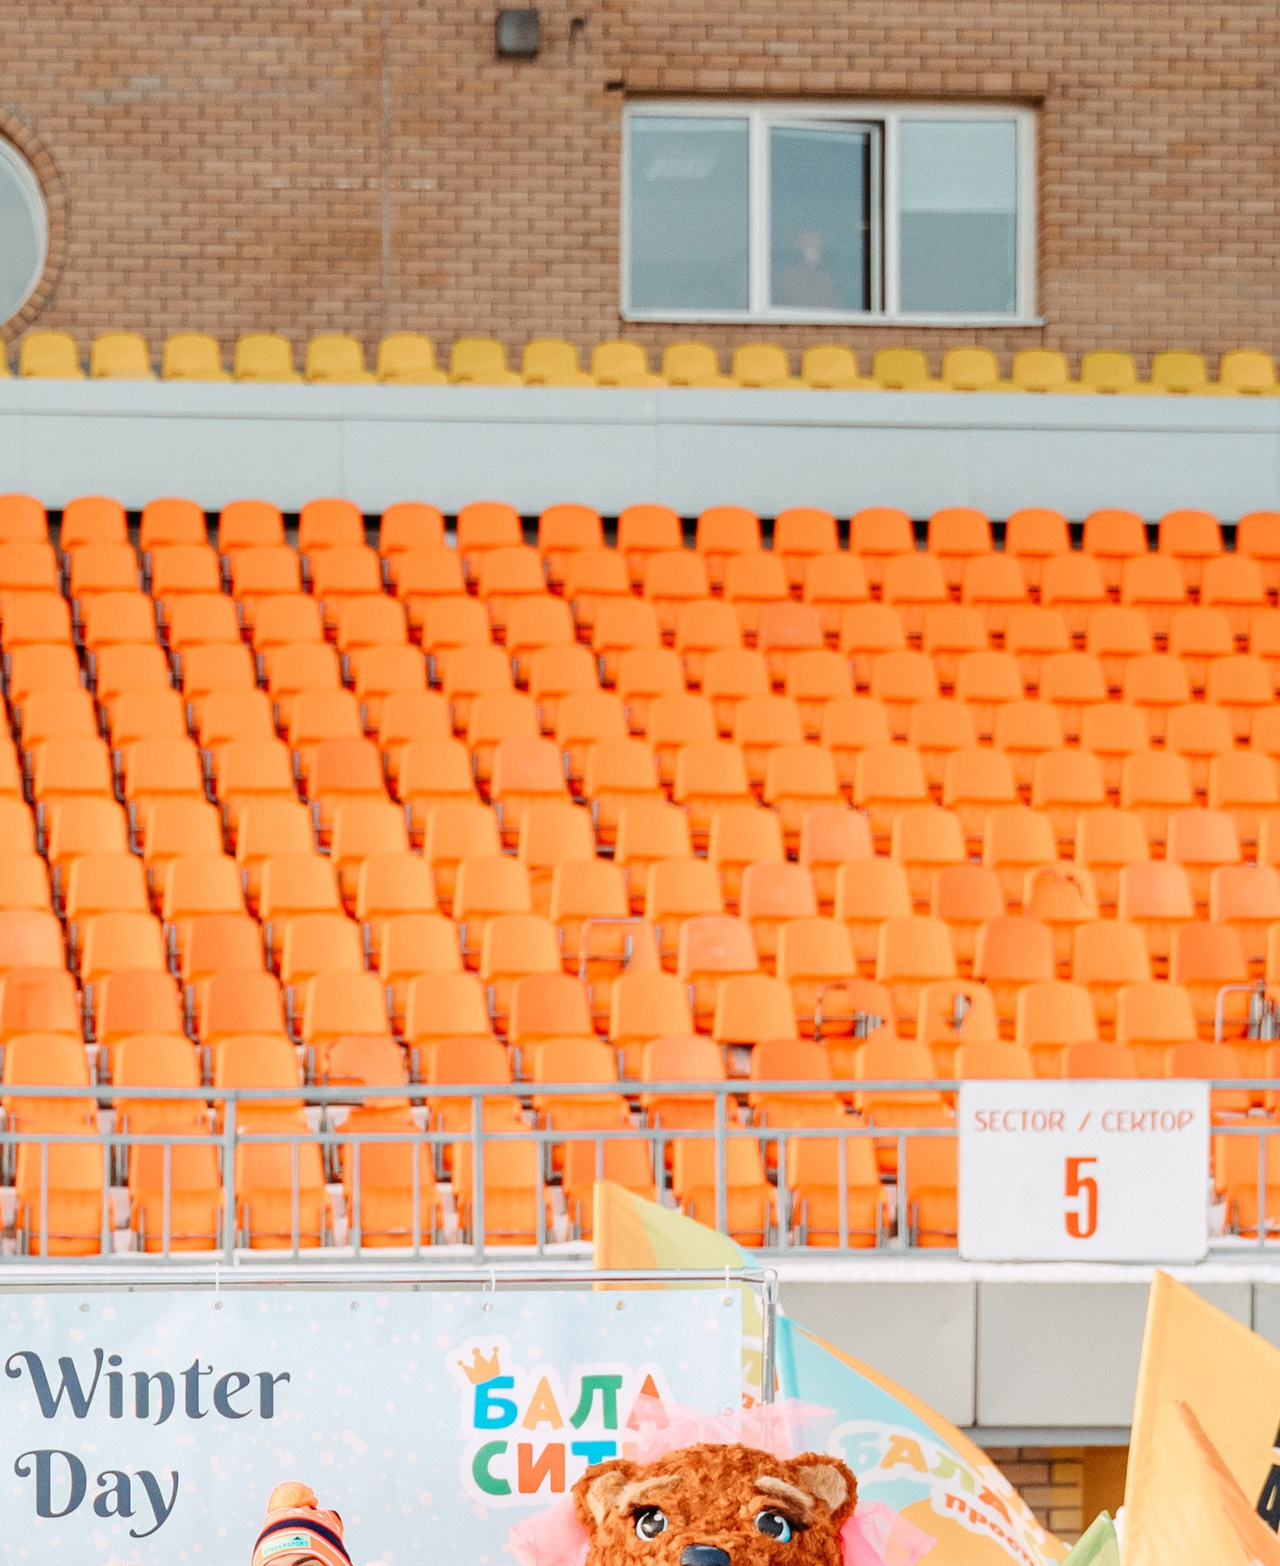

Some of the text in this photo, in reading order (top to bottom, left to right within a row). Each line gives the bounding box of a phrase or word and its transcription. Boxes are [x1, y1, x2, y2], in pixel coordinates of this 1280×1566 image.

[974, 1109, 1065, 1132] SECTOR
[1101, 1109, 1195, 1132] СЕКТОР
[1064, 1156, 1098, 1239] 5
[4, 1347, 291, 1427] Winter
[473, 1373, 671, 1431] БАЛА
[14, 1448, 179, 1538] Day
[472, 1440, 645, 1496] СИТ
[839, 1431, 1014, 1528] БАЛА
